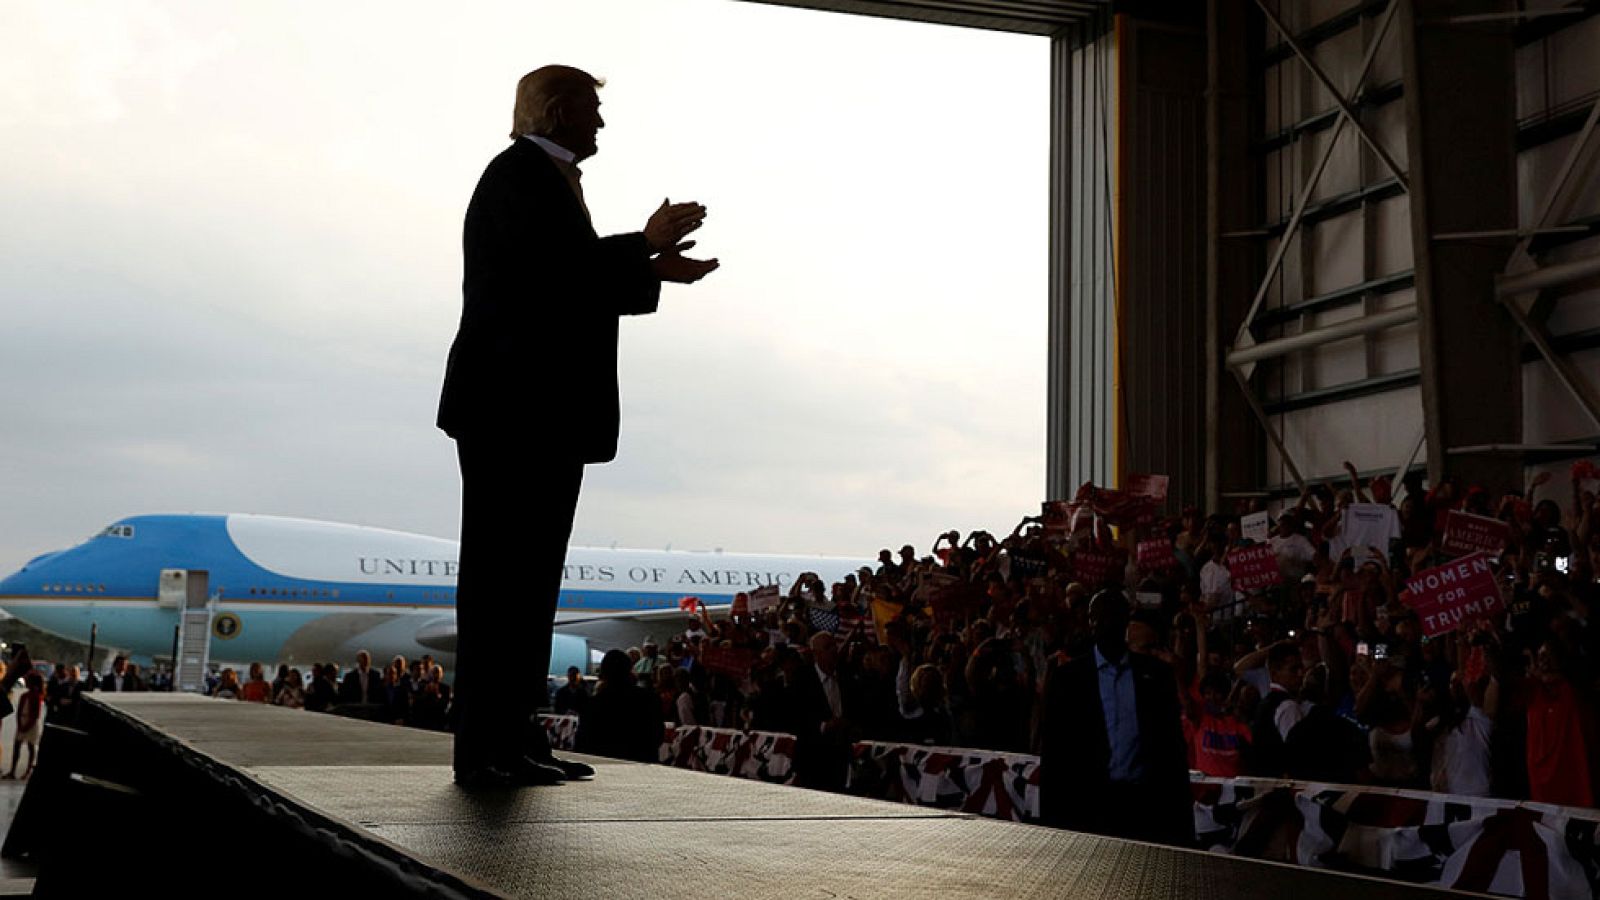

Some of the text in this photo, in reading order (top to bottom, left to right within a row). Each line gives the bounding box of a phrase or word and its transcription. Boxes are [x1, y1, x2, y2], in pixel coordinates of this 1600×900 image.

[359, 559, 459, 575] UNITE
[629, 567, 666, 583] OF
[678, 569, 791, 587] AMERIC
[1408, 558, 1488, 595] WOMEN
[1437, 587, 1466, 605] FOR
[1425, 595, 1495, 630] TRUMP
